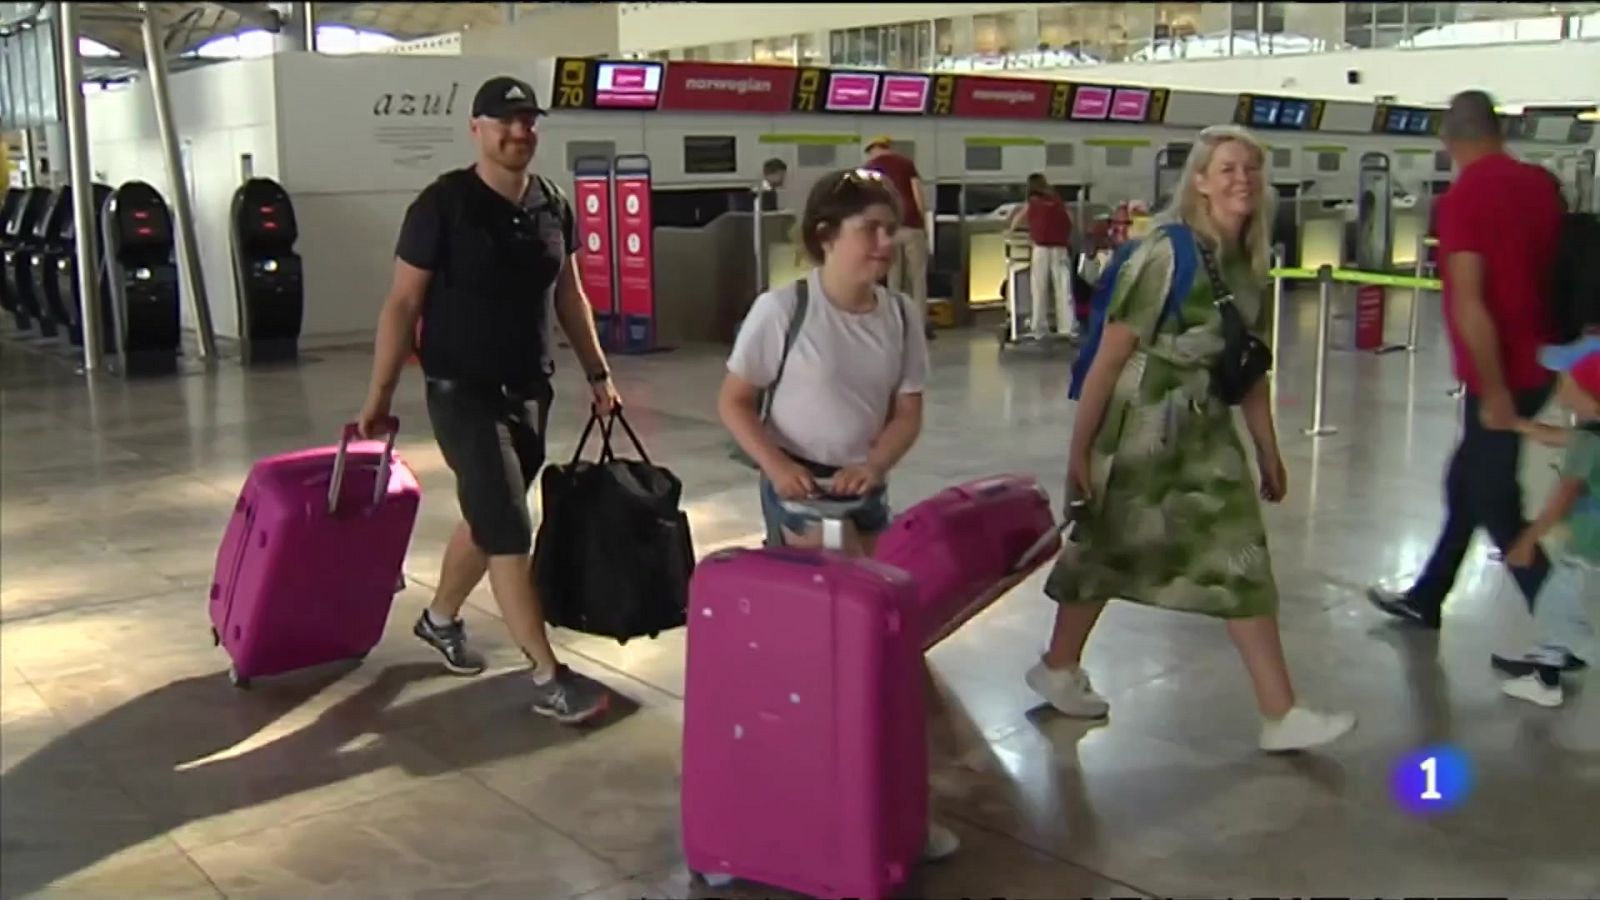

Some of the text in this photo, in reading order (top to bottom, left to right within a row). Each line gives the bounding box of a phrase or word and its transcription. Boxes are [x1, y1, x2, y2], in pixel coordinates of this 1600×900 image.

[685, 77, 771, 95] norwegian
[373, 82, 458, 116] azul
[560, 87, 583, 106] 70
[799, 93, 815, 110] 71
